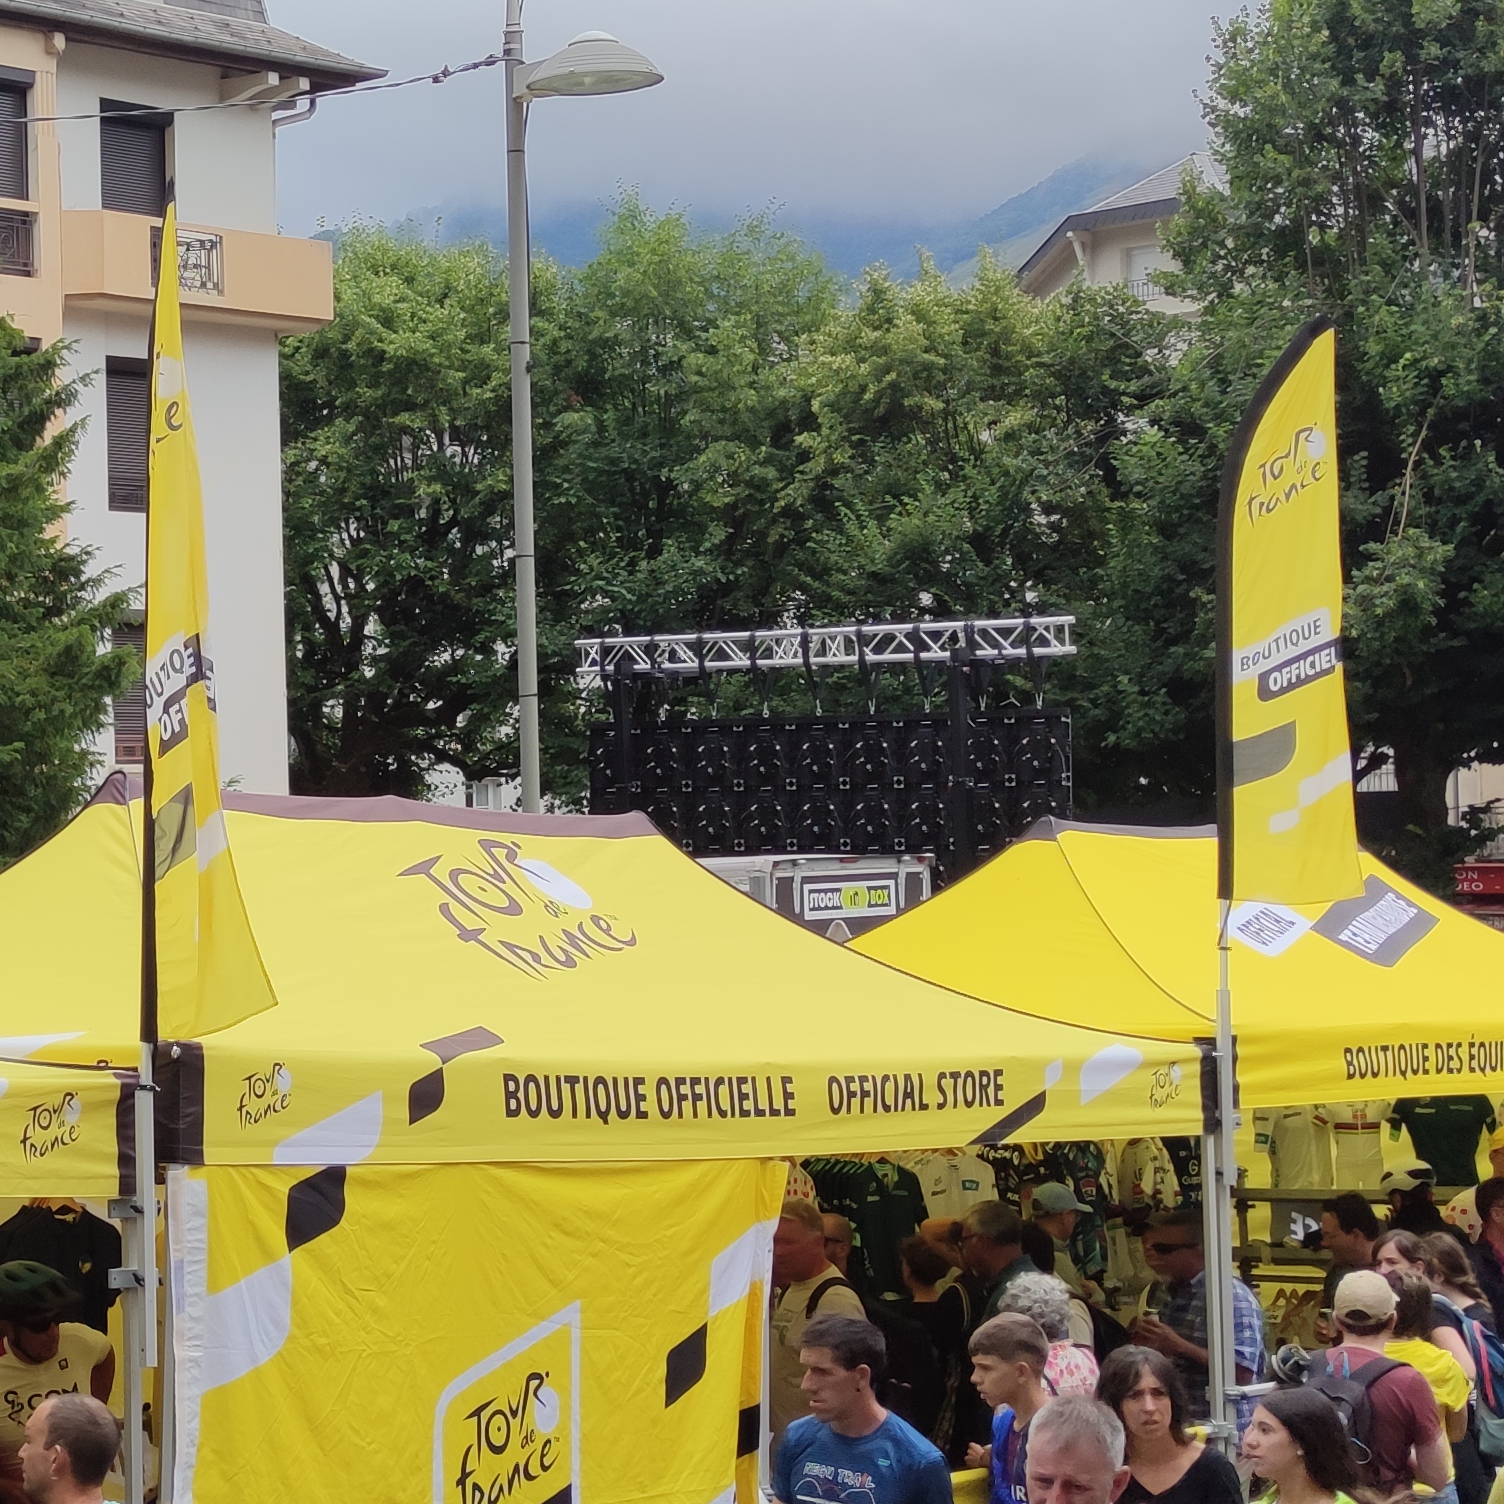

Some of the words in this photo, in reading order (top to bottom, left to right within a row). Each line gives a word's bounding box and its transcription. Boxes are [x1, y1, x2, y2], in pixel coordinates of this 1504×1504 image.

[1240, 616, 1323, 674] BOUTIQUE
[396, 838, 551, 928] TOUR
[809, 892, 841, 909] STOCK
[869, 889, 889, 905] BOX
[1342, 1043, 1430, 1081] BOUTIQUE
[1434, 1040, 1464, 1075] DES
[502, 1072, 650, 1125] BOUTIQUE
[655, 1072, 797, 1120] OFFICIELLE
[827, 1071, 931, 1117] OFFICIAL
[935, 1067, 1006, 1112] STORE
[463, 1371, 551, 1455] TOUR
[521, 1426, 537, 1451] de
